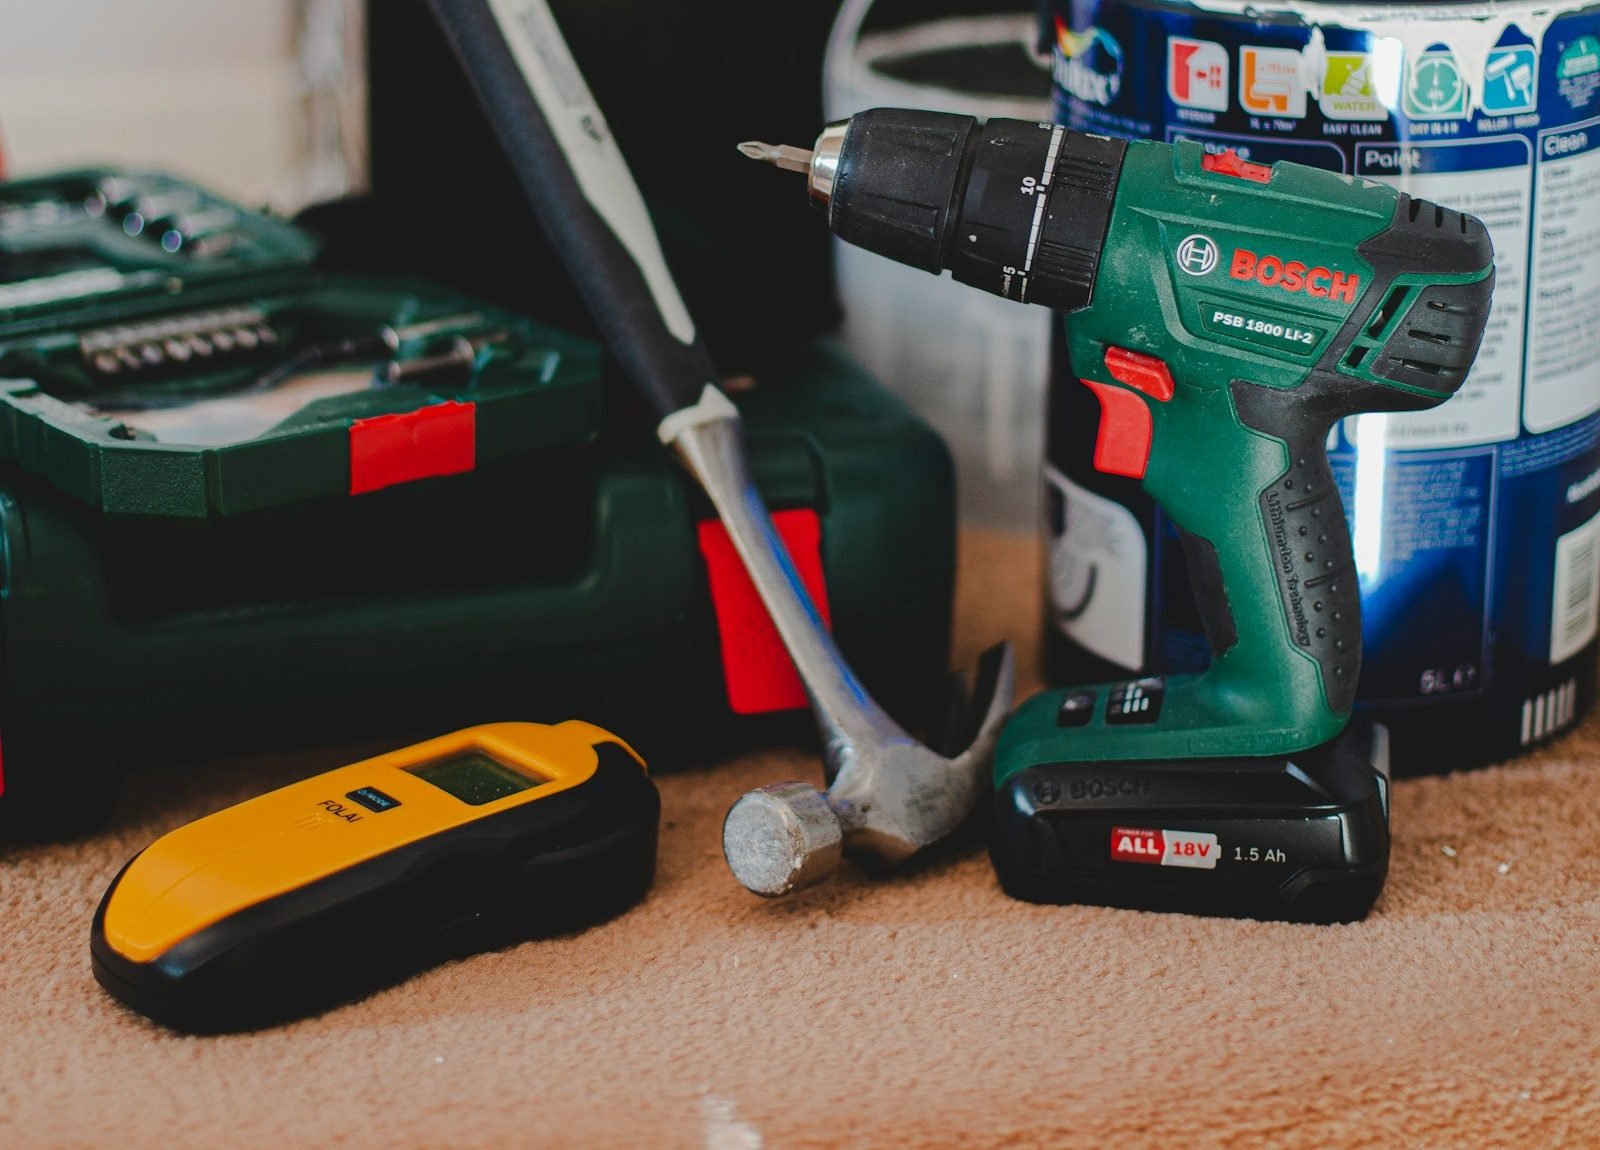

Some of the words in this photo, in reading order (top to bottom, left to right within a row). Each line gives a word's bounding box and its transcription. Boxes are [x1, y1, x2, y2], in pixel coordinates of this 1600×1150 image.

[1333, 102, 1376, 112] WATER
[1323, 123, 1348, 135] EASY
[1350, 123, 1382, 136] CLEAN
[1544, 132, 1588, 156] Clean
[1365, 149, 1420, 169] Paint
[1020, 176, 1037, 196] 10
[1003, 265, 1016, 275] 5
[1229, 248, 1360, 305] BOSCH
[1213, 311, 1245, 328] PSB
[1245, 319, 1283, 337] 1800
[1284, 328, 1314, 345] LI-2
[1070, 778, 1150, 799] BOSCH
[316, 799, 364, 823] FOLAI
[1117, 835, 1160, 855] ALL
[1173, 841, 1210, 857] 18V
[1233, 846, 1260, 862] 1.5
[1264, 848, 1286, 863] Ah
